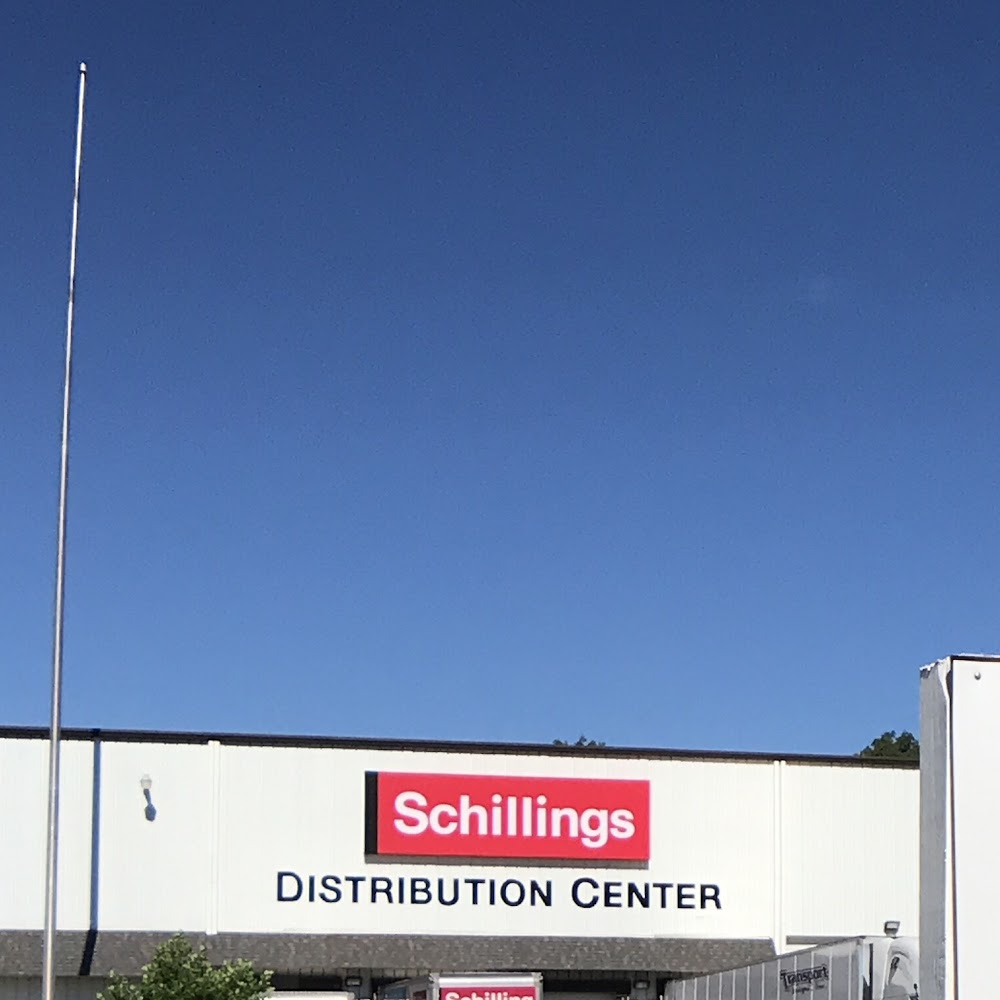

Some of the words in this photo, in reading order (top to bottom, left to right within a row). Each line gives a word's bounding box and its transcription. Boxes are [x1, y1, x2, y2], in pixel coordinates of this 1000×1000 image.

[393, 790, 636, 848] Schillings
[277, 871, 552, 907] DISTRIBUTION
[570, 877, 723, 910] CENTER
[780, 966, 828, 989] Transport
